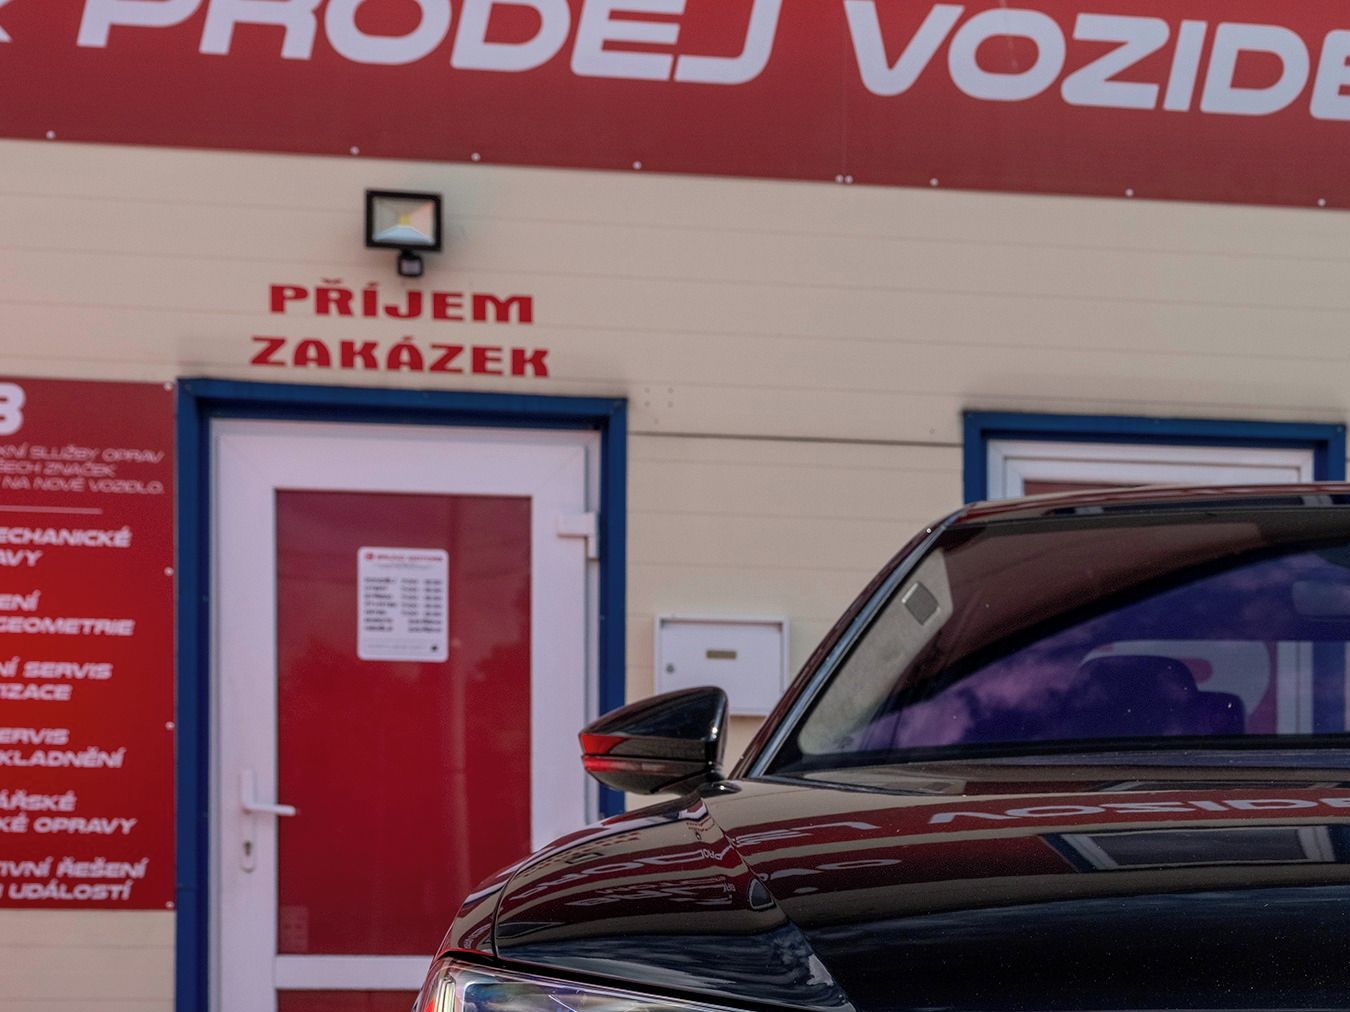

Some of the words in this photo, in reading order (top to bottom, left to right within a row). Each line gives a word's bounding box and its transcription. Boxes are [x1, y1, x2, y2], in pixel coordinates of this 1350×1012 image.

[269, 278, 533, 324] PŘÍJEM
[251, 335, 549, 377] ZAKÁZEK
[29, 444, 99, 462] SLUŽBY
[101, 448, 165, 464] OPRAV
[43, 461, 116, 478] ZNAČEK
[2, 475, 31, 490] NA
[33, 475, 86, 492] NOVÉ
[23, 661, 113, 680] SERVIS
[33, 816, 137, 835] OPRAVY
[56, 856, 149, 879] ŘEŠENÍ
[8, 880, 133, 900] UDÁLOSTÍ
